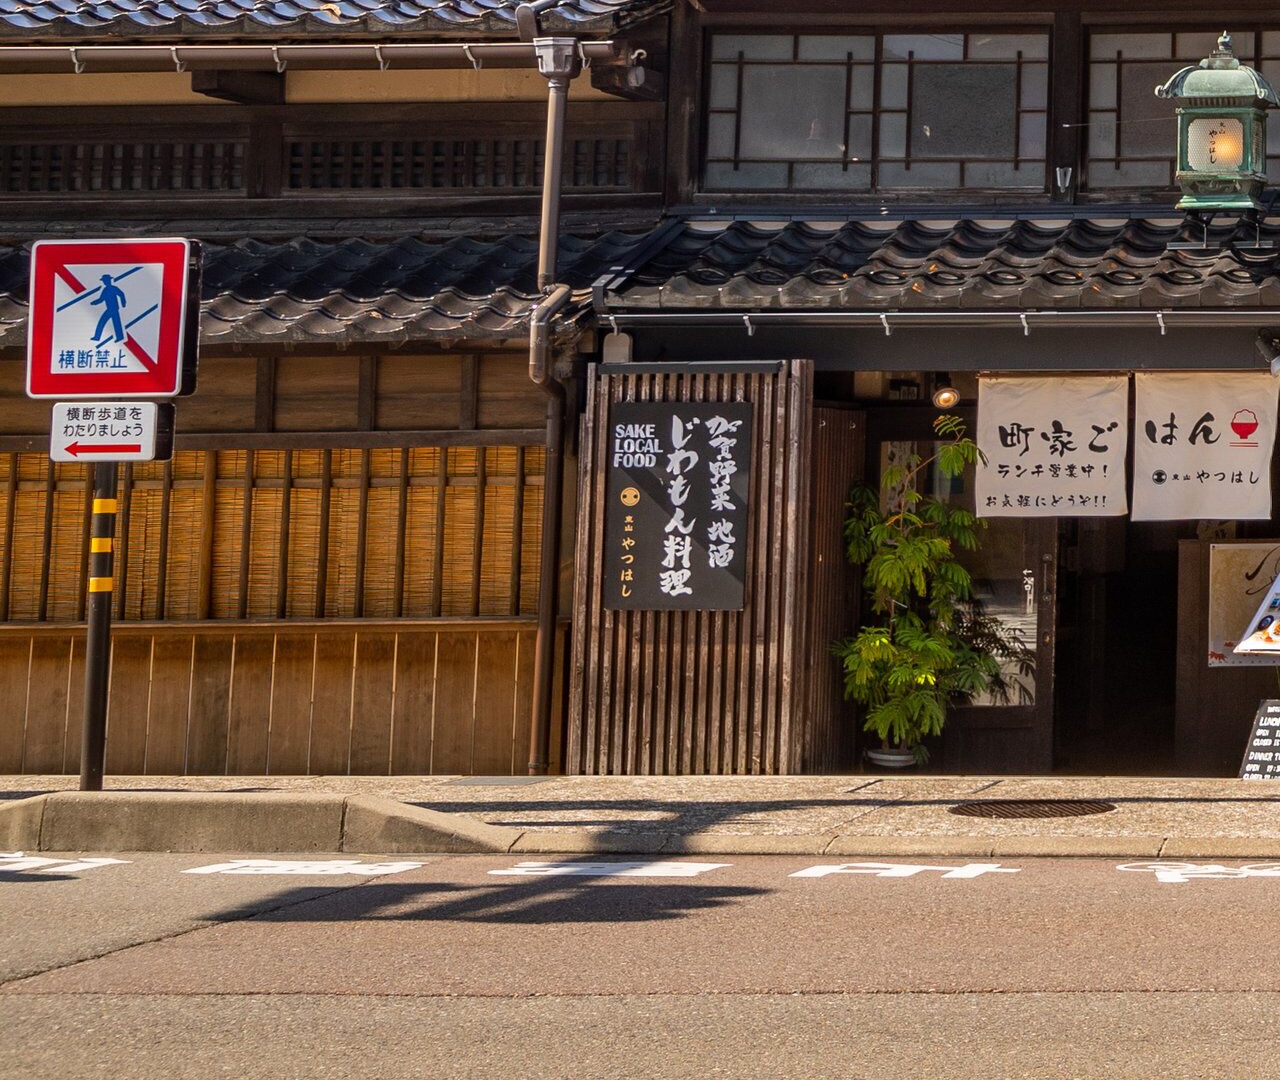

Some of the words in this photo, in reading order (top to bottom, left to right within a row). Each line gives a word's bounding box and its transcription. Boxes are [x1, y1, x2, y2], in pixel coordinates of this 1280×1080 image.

[58, 349, 128, 369] 横断禁止
[67, 407, 142, 421] 横断歩道を
[63, 422, 143, 437] わたりましょう
[615, 424, 655, 439] SAKE
[615, 438, 663, 454] LOCAL
[613, 453, 657, 468] FOOD
[704, 414, 742, 511] 加賀野菜
[1196, 470, 1260, 485] やつはし
[659, 414, 700, 597] じわもん料理
[707, 518, 737, 569] 地酒
[620, 536, 636, 598] やつはし
[1256, 729, 1269, 737] OPEN
[1248, 751, 1273, 761] DINNER
[1245, 764, 1260, 772] OPEN
